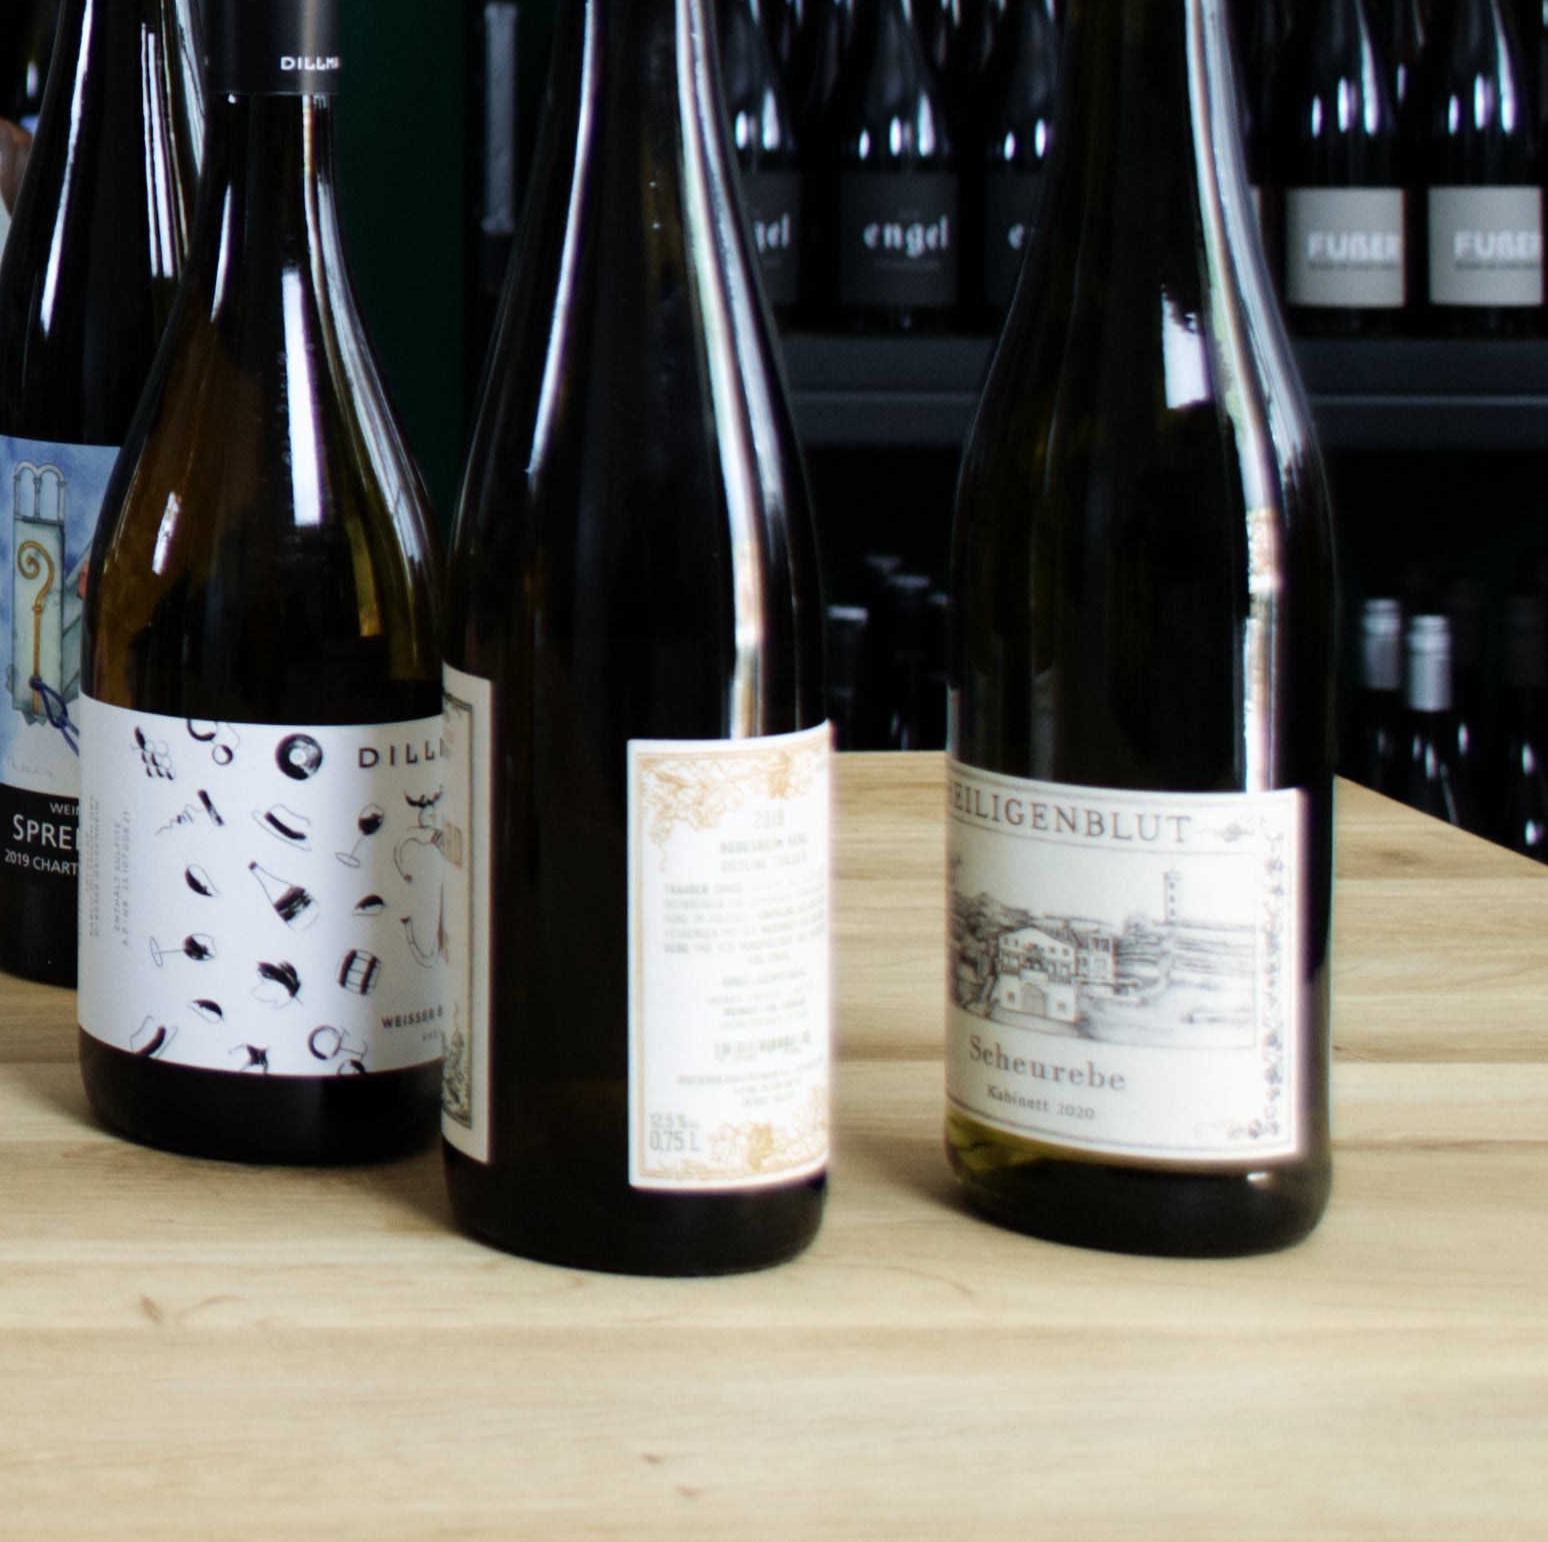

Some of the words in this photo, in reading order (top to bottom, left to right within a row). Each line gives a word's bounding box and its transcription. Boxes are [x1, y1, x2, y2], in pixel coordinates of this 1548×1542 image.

[4, 848, 30, 867] 2019
[381, 1007, 434, 1029] WEISSER
[969, 1033, 1126, 1091] Scheurebe
[987, 1084, 1049, 1113] Kabinett
[1056, 1102, 1096, 1120] 2020
